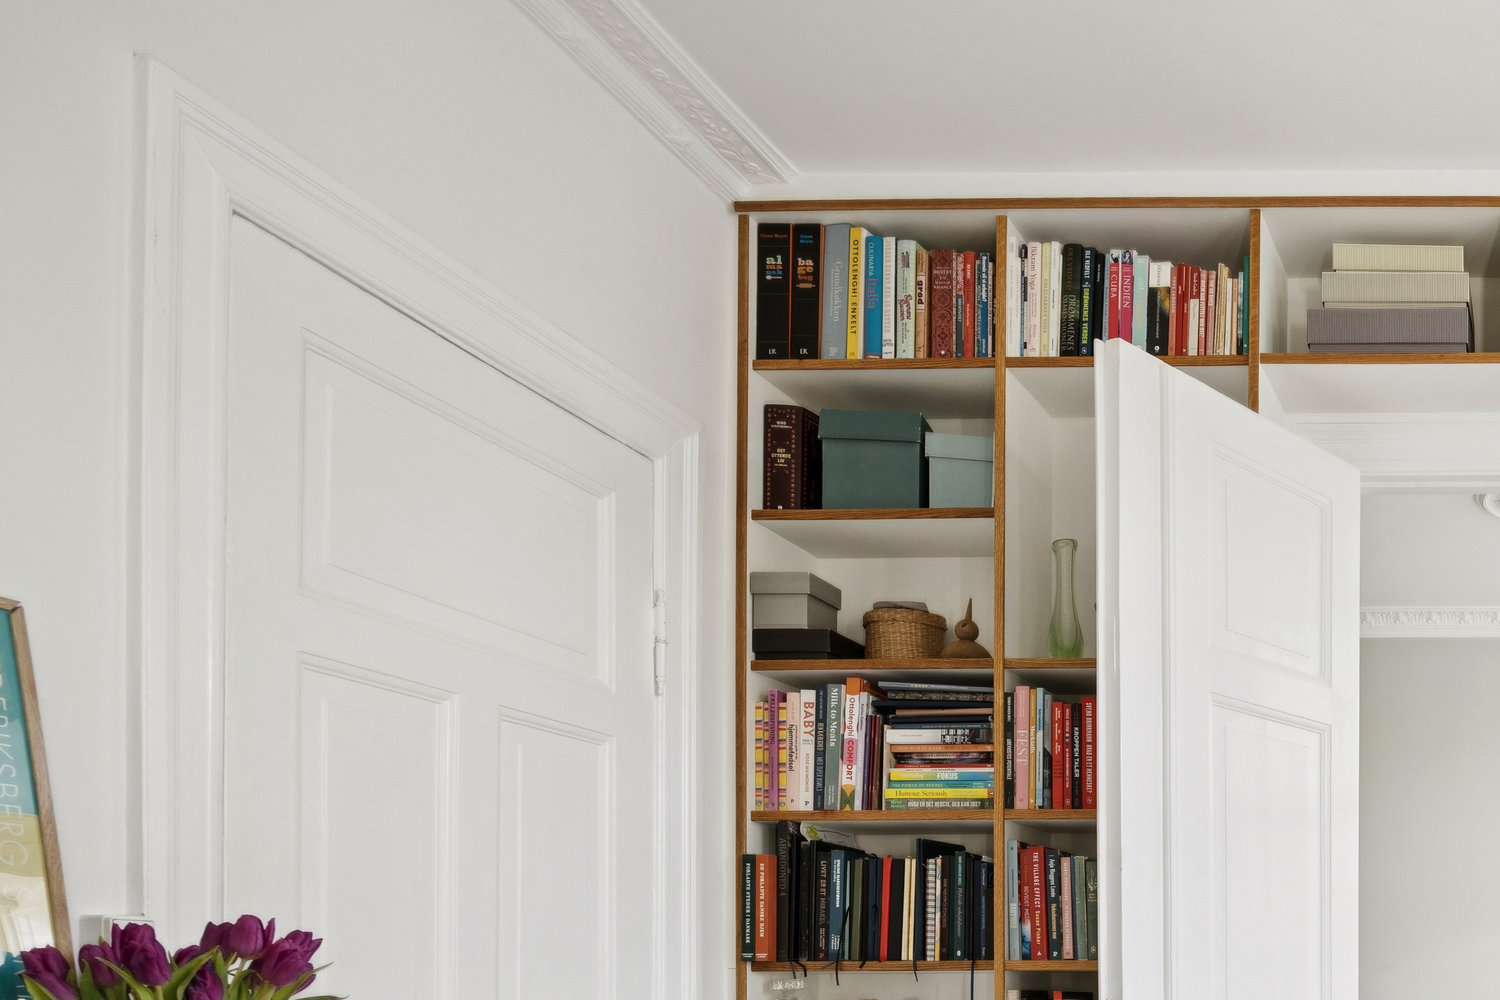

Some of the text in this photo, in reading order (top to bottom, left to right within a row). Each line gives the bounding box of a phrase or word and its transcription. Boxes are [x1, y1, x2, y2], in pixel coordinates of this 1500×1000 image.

[850, 239, 860, 334] OTTOLENGHI ENKELT
[868, 278, 880, 309] Italia
[1028, 273, 1037, 290] Yoga
[1123, 275, 1131, 308] INDIEN
[1067, 294, 1076, 351] DRØMMENES
[829, 687, 839, 747] Milk to Meals
[846, 697, 856, 781] Ottolenghi COMFORT
[1016, 729, 1029, 765] FEST
[779, 837, 787, 890] ABANDONED
